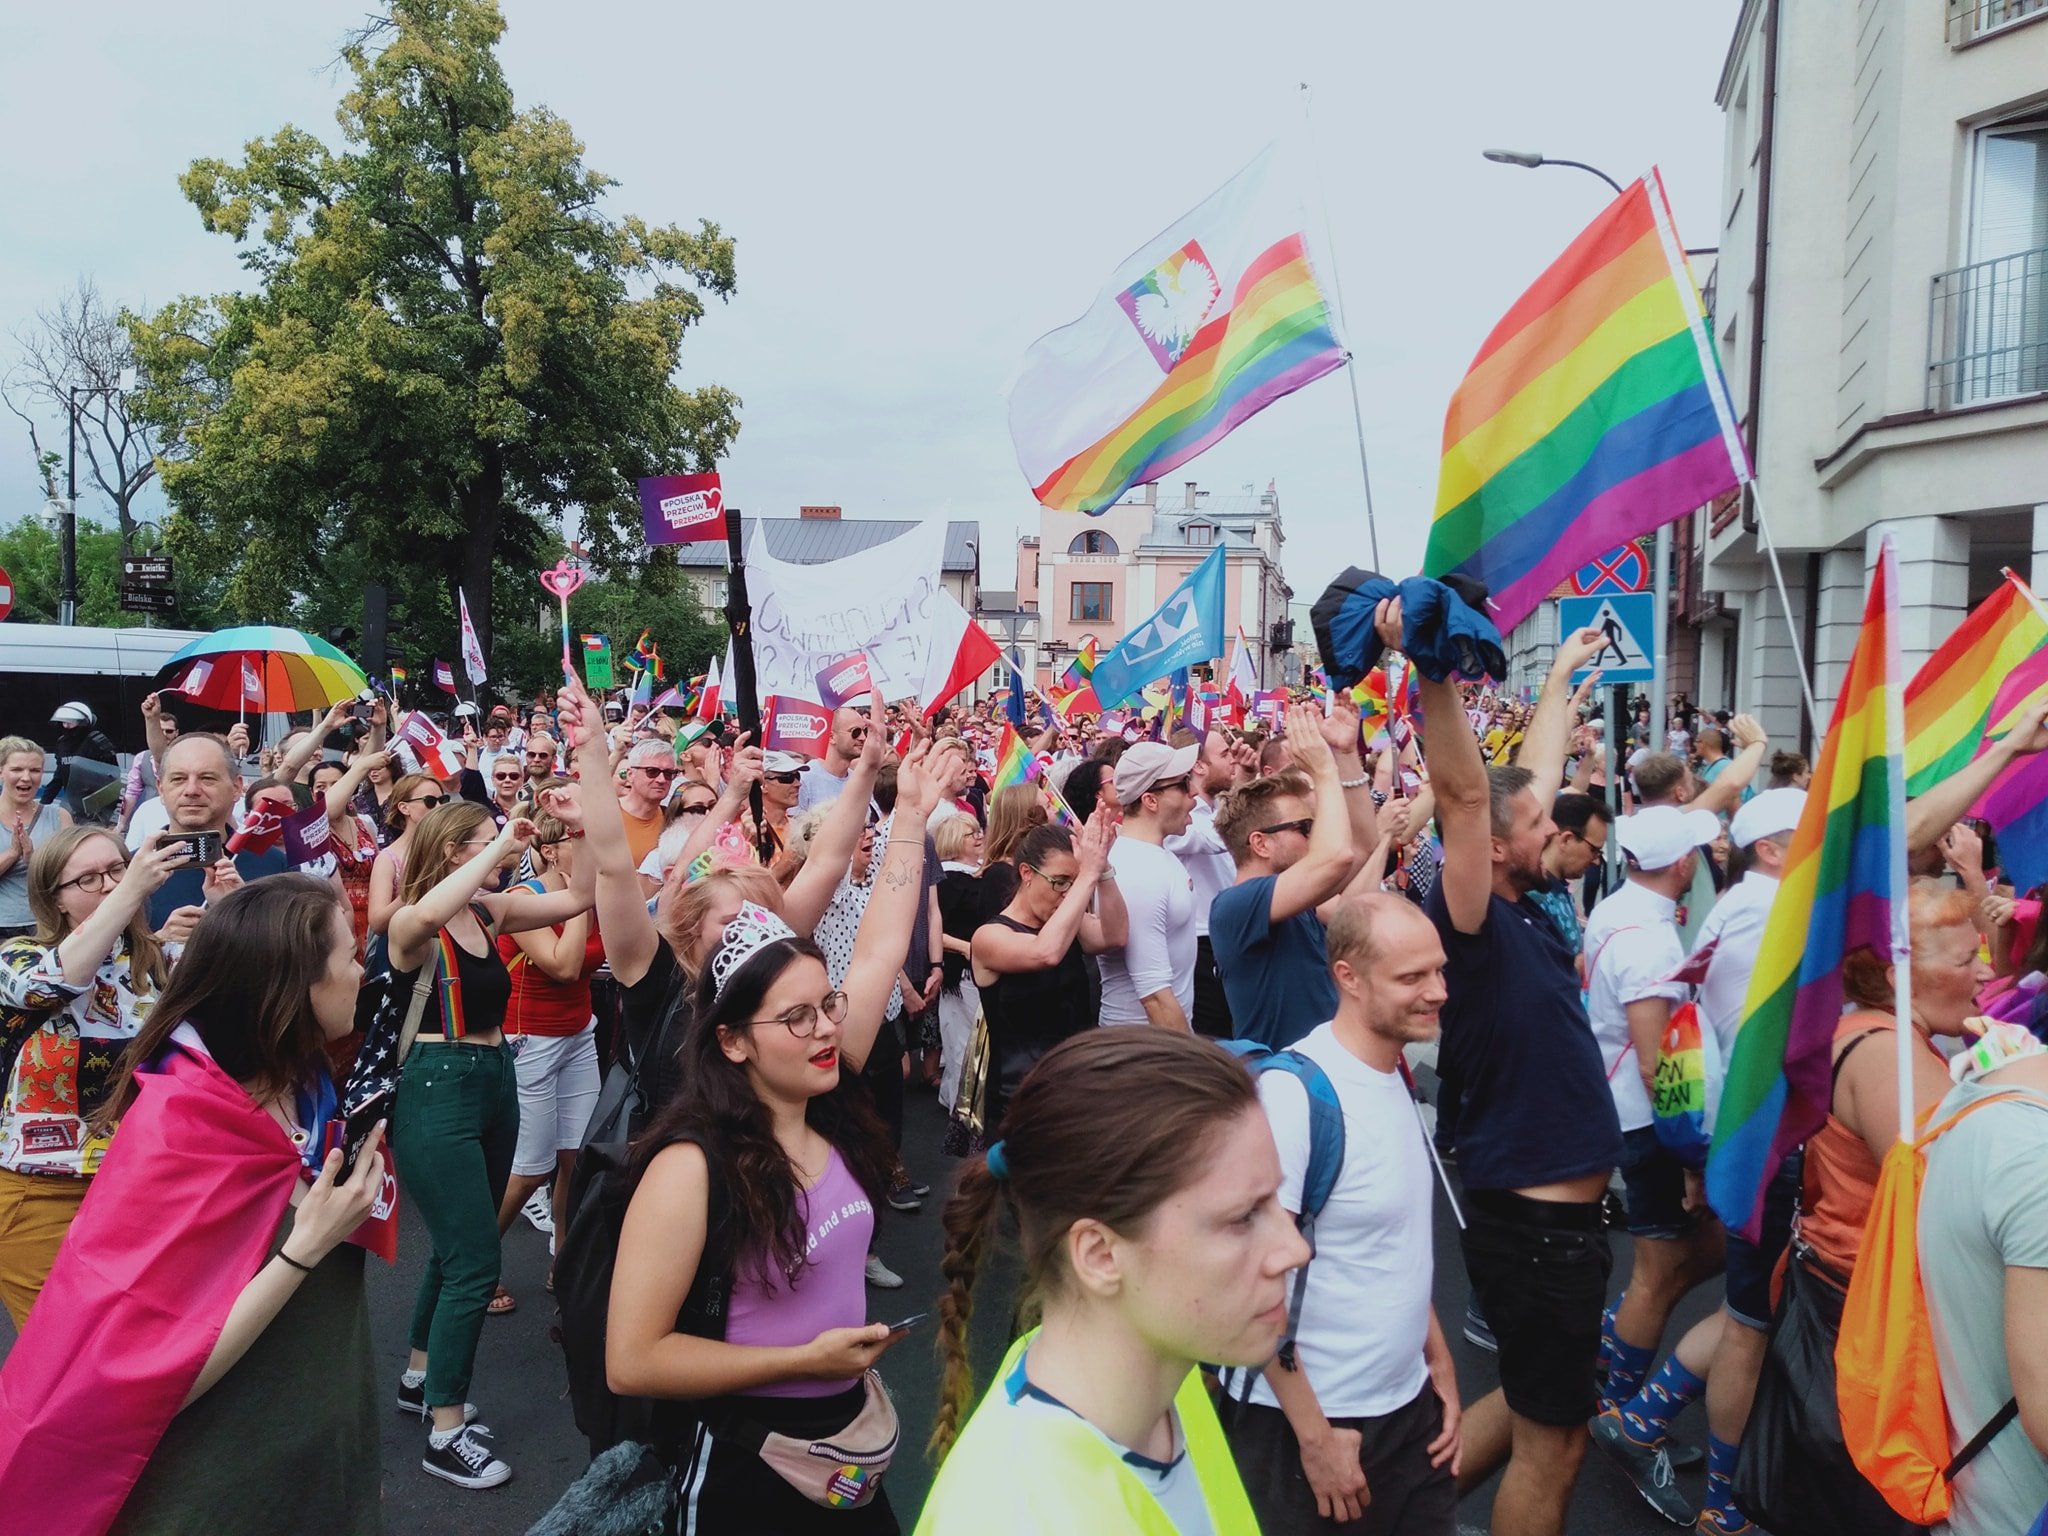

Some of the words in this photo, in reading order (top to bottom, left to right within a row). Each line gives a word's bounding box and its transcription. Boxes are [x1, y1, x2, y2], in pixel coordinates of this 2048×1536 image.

[664, 494, 701, 508] #POLSKA
[666, 503, 704, 518] PRZECIW
[673, 510, 714, 527] PRZEMOCY
[778, 714, 809, 722] #POLSKA
[778, 721, 810, 729] PRZECIW
[780, 729, 816, 737] PRZEMOCY
[818, 1210, 840, 1238] and
[841, 1200, 873, 1219] sassy
[838, 1475, 862, 1490] razem
